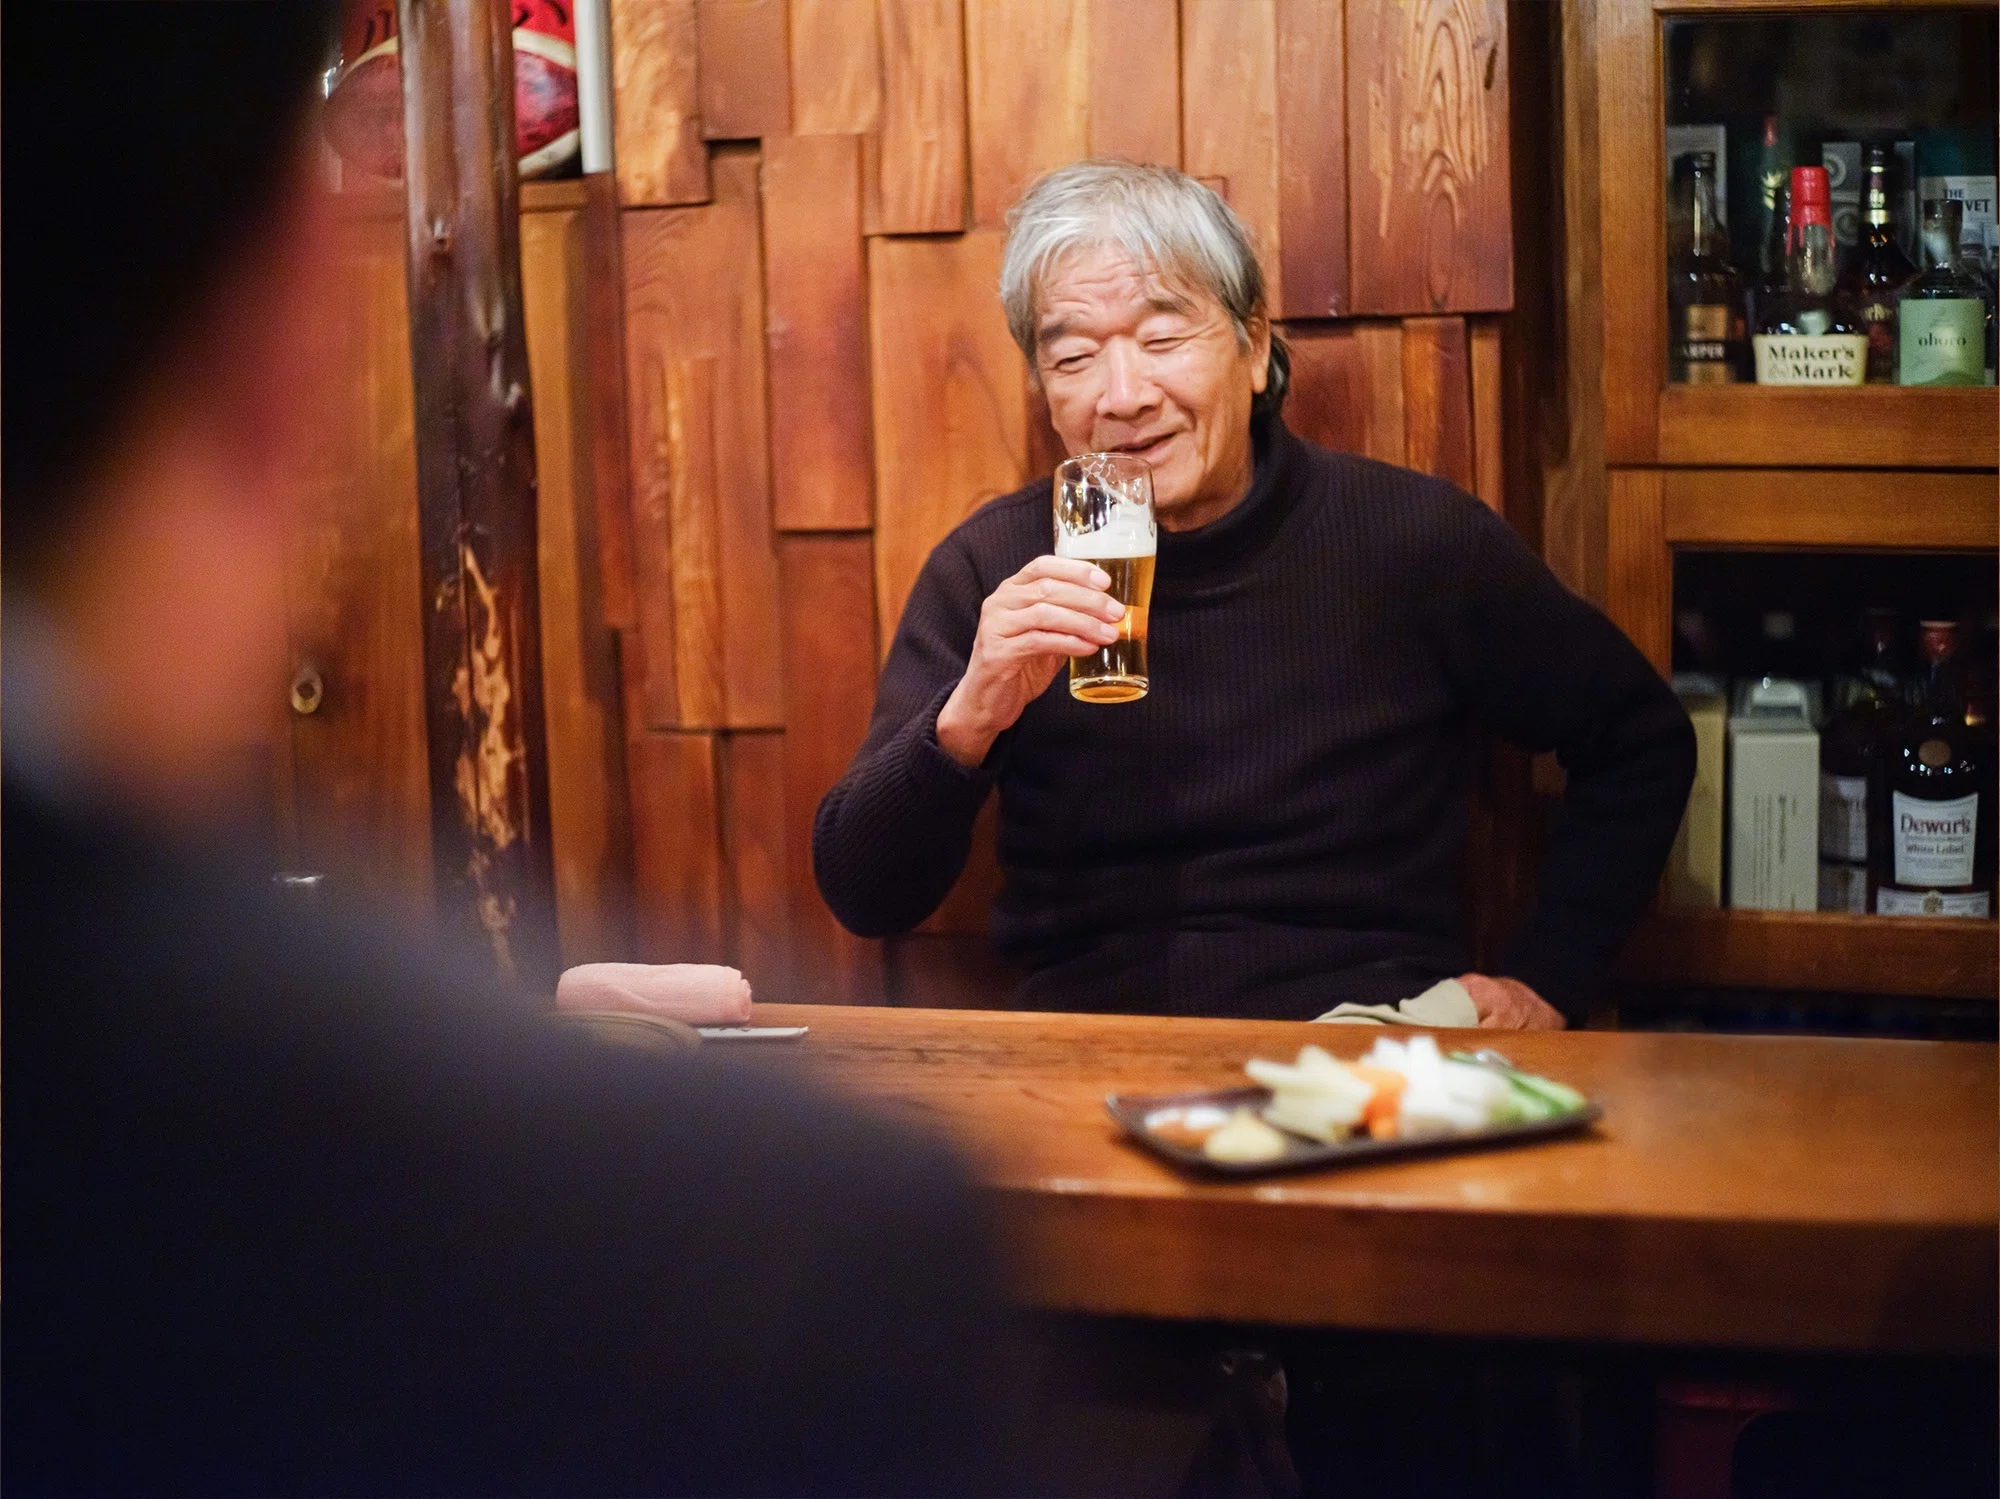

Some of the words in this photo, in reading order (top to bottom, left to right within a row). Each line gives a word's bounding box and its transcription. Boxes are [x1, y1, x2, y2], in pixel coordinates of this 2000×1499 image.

[1944, 189, 1964, 199] THE
[1965, 199, 1991, 212] VET
[1768, 345, 1855, 360] Maker's
[1793, 364, 1855, 379] Mark
[1900, 812, 1970, 834] Dewar's
